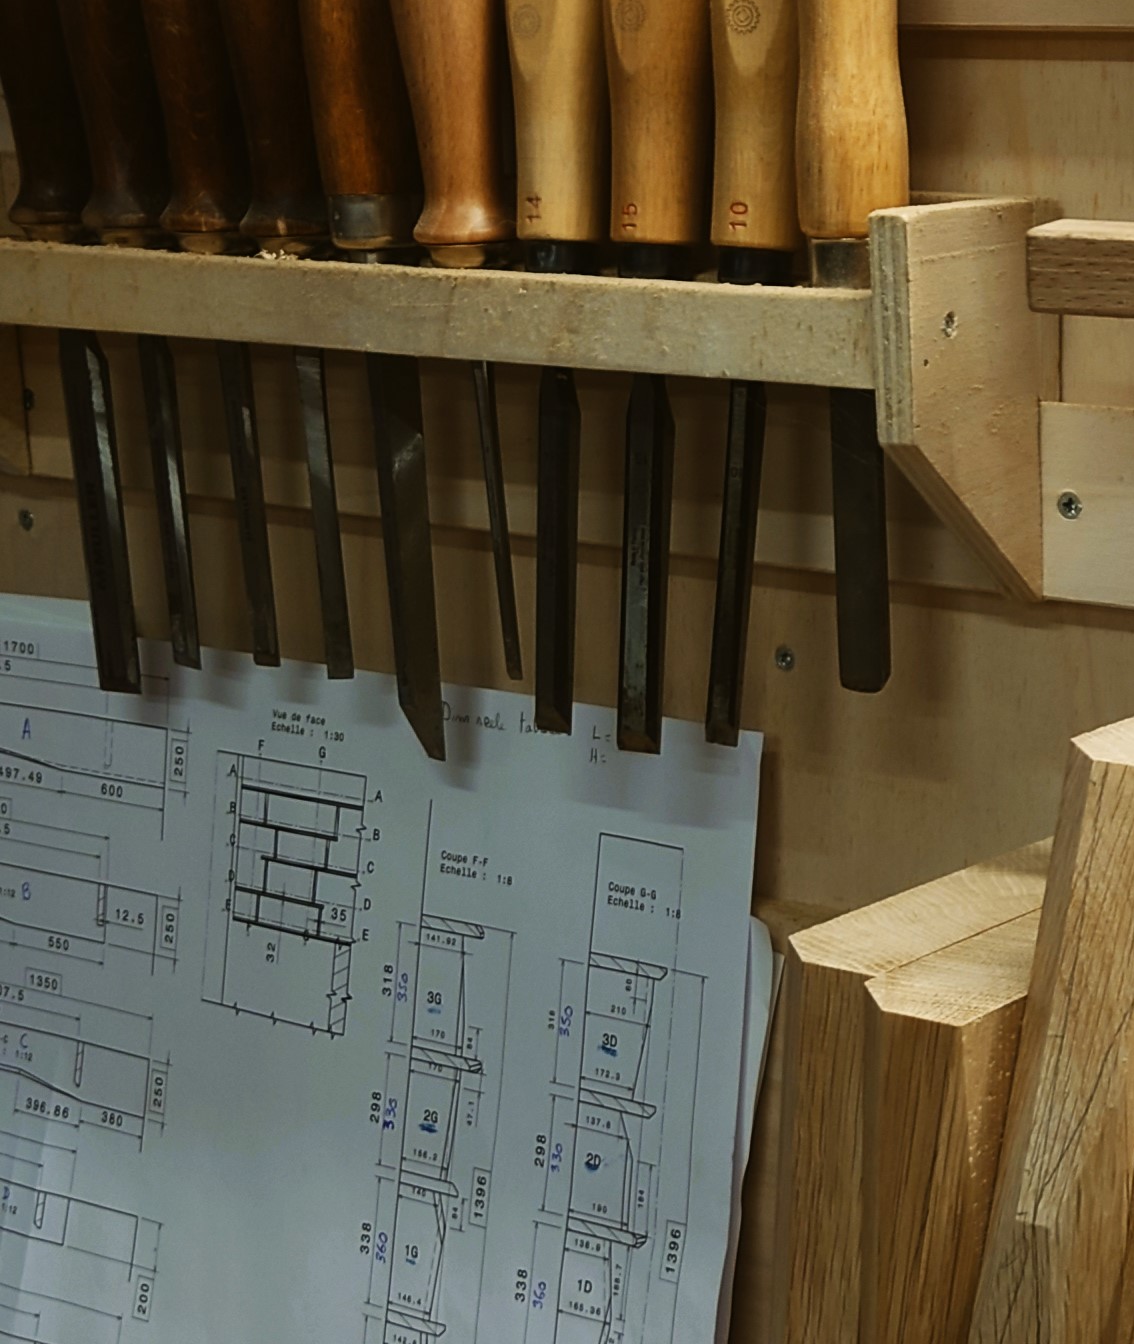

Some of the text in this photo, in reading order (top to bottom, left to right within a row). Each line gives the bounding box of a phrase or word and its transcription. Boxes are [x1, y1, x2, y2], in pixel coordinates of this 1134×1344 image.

[526, 195, 542, 223] 14
[622, 203, 638, 231] 15
[729, 201, 748, 231] 10
[3, 640, 35, 655] 1700
[272, 709, 326, 726] Vue de face
[22, 718, 31, 740] A
[271, 721, 305, 736] Echelle
[324, 730, 345, 743] 1:30
[258, 739, 265, 751] F
[319, 746, 327, 759] G
[173, 745, 185, 777] 250
[229, 764, 238, 777] A
[101, 783, 123, 798] 600
[374, 790, 383, 803] A
[373, 829, 381, 841] B
[441, 850, 488, 867] Coupe F-F
[367, 861, 375, 874] C
[440, 863, 477, 879] Echelle
[608, 881, 657, 900] Coupe G-G
[364, 898, 372, 910] D
[607, 895, 645, 911] Echelle
[115, 908, 145, 925] 12.5
[331, 908, 347, 922] 35
[164, 913, 175, 944] 250
[362, 929, 370, 941] E
[48, 936, 70, 951] 550
[266, 942, 276, 963] 32
[29, 974, 58, 990] 1350
[382, 964, 394, 997] 318
[397, 972, 409, 1003] 350
[427, 991, 442, 1005] 3G
[610, 1004, 627, 1015] 210
[560, 1006, 573, 1036] 350
[20, 1033, 29, 1048] C
[431, 1029, 446, 1040] 170
[602, 1033, 618, 1047] 3D
[153, 1077, 164, 1107] 250
[25, 1097, 69, 1119] 396.86
[370, 1091, 382, 1123] 298
[101, 1111, 123, 1127] 380
[423, 1109, 438, 1123] 2G
[534, 1134, 547, 1168] 298
[550, 1143, 563, 1173] 330
[586, 1152, 602, 1167] 2D
[474, 1176, 487, 1219] 1396
[360, 1222, 372, 1255] 338
[375, 1232, 388, 1264] 360
[405, 1244, 419, 1259] 1G
[665, 1229, 682, 1274] 1396
[514, 1269, 528, 1303] 338
[577, 1279, 593, 1294] 1D
[137, 1283, 150, 1315] 200
[532, 1281, 547, 1310] 360
